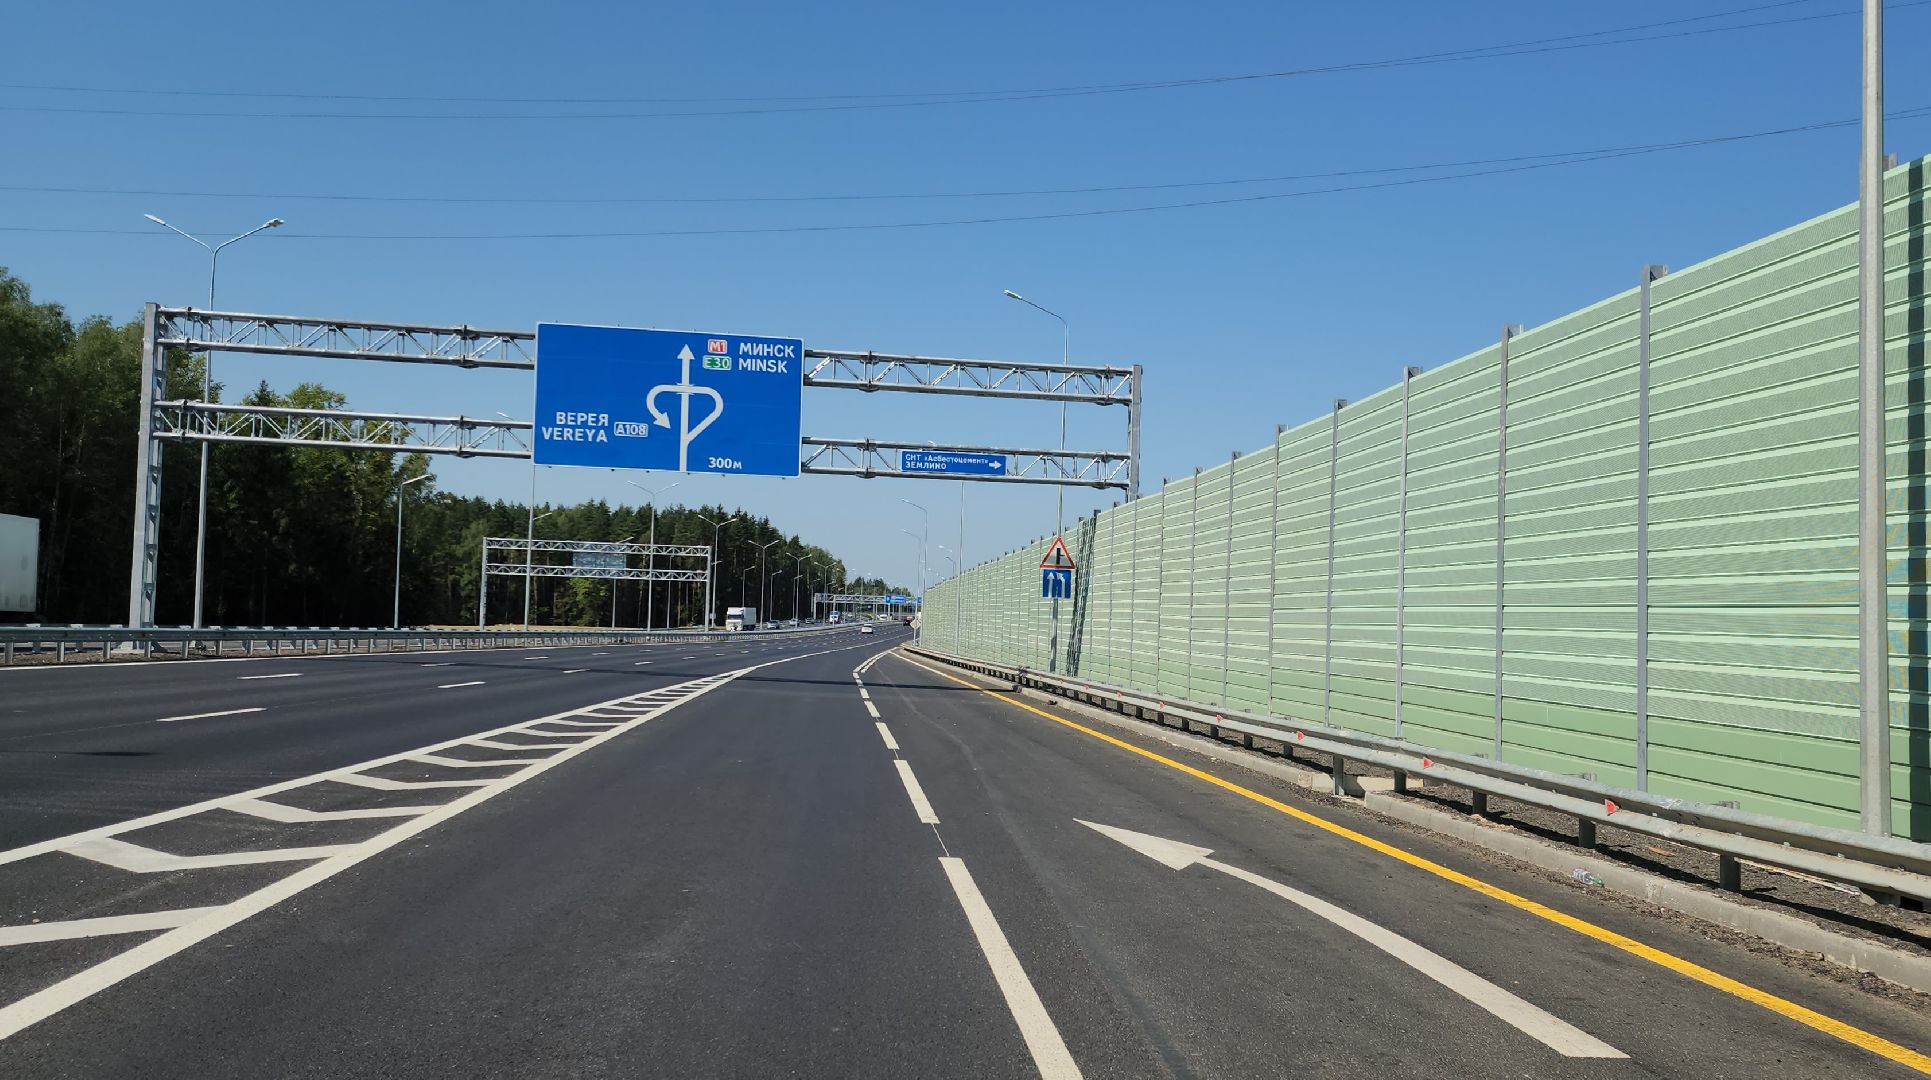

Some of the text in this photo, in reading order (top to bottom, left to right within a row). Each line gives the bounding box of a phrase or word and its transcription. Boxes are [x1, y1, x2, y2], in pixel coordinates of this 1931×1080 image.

[739, 342, 795, 358] МИНСК
[738, 359, 787, 374] MINSK
[556, 411, 609, 427] ВЕРЕЯ
[542, 426, 608, 443] VEREYA
[905, 462, 947, 470] ЗЕМЛИНО
